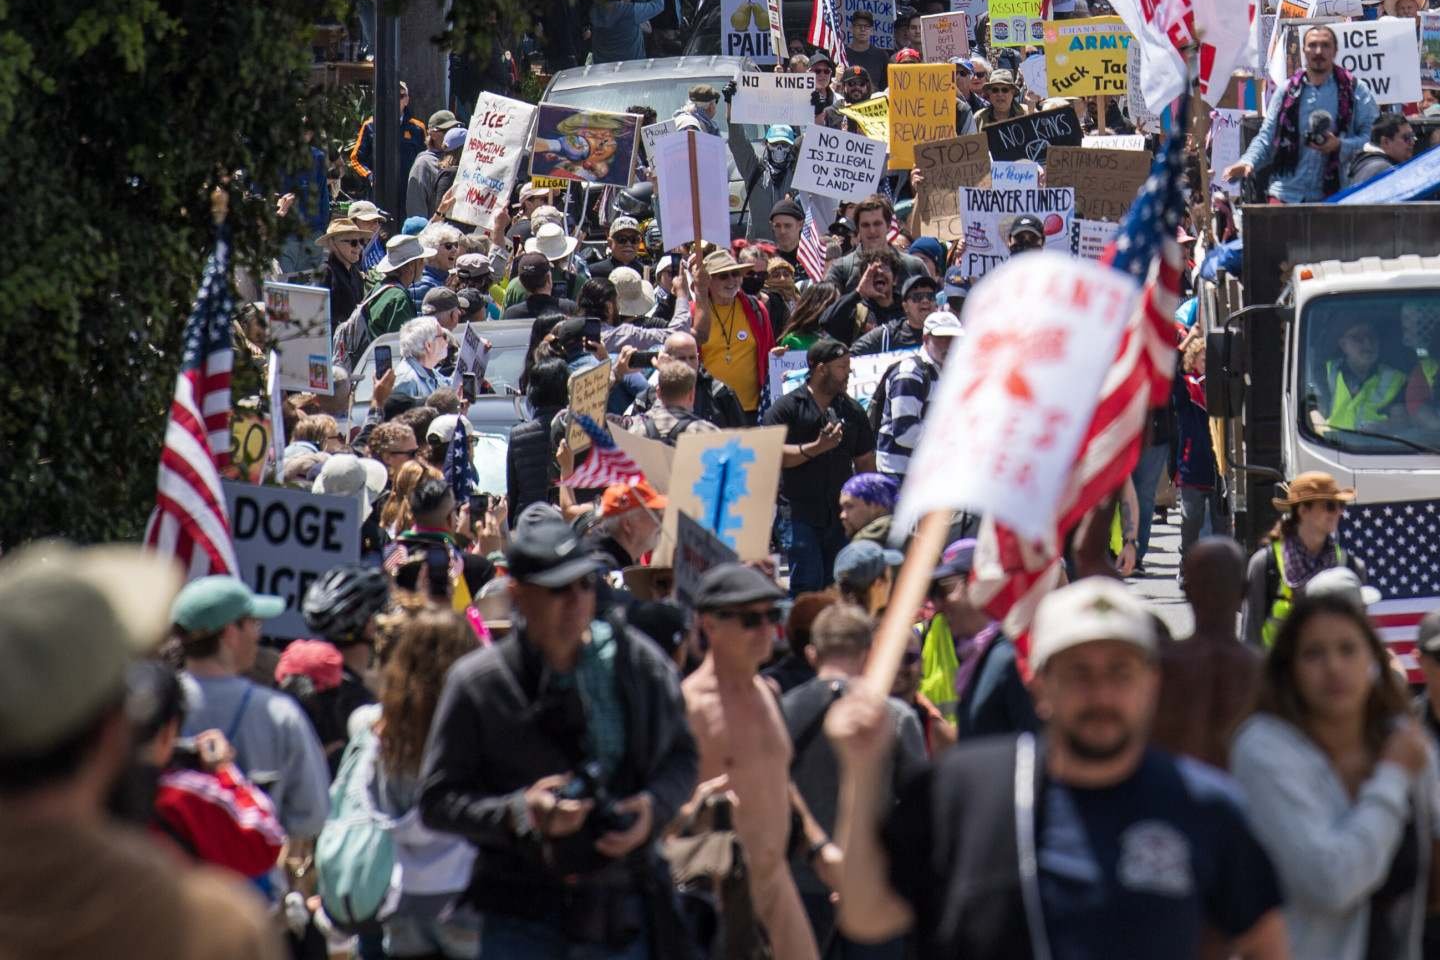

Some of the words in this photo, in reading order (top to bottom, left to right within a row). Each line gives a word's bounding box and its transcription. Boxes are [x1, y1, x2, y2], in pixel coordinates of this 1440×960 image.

[990, 1, 1043, 15] ASSISTIN
[1069, 34, 1132, 52] ARMY
[1343, 29, 1379, 47] ICE
[1341, 52, 1386, 72] OUT
[742, 75, 759, 88] NO
[775, 75, 815, 90] KINGS
[893, 70, 911, 90] NO
[1051, 66, 1090, 93] fuck
[893, 97, 927, 118] VIVE
[933, 98, 949, 117] LA
[482, 111, 506, 128] ICE
[468, 137, 506, 158] ABDUCTING
[818, 132, 841, 150] NO
[846, 138, 875, 156] ONE
[998, 126, 1025, 150] NO
[806, 149, 825, 160] IS
[827, 151, 876, 171] ILLEGAL
[920, 141, 980, 168] STOP
[1050, 152, 1120, 170] GRITAMOS
[533, 178, 568, 189] ILLEGAL
[812, 164, 829, 176] ON
[834, 167, 875, 184] STOLEN
[815, 175, 856, 193] LAND!
[1005, 166, 1034, 183] People
[965, 189, 1022, 213] TAXPAYER
[1024, 188, 1073, 213] FUNDED
[773, 358, 796, 369] They
[233, 495, 346, 553] DOGE
